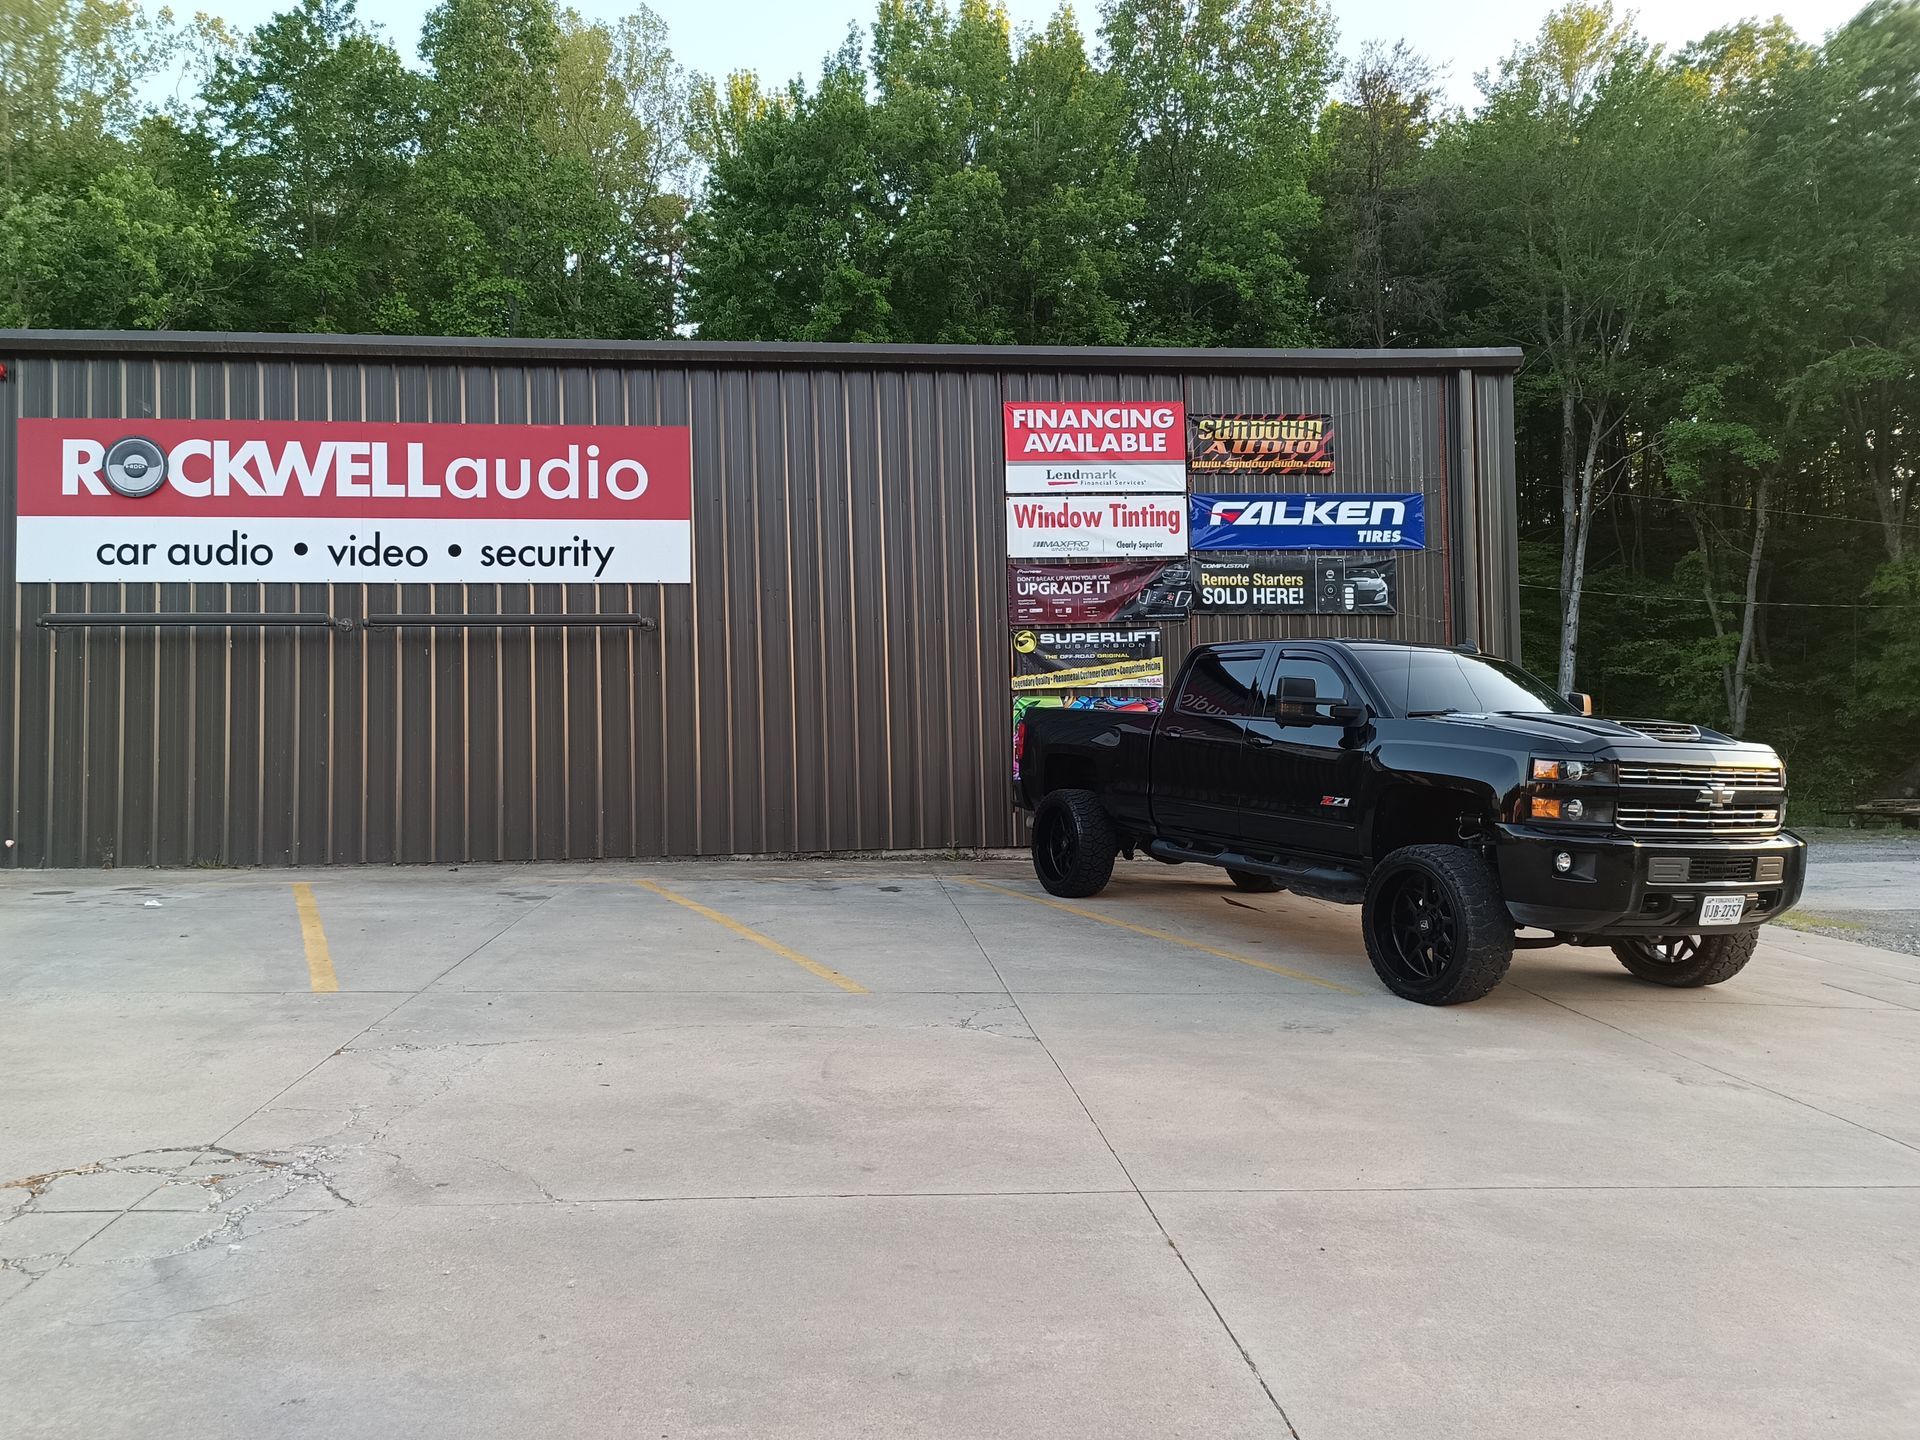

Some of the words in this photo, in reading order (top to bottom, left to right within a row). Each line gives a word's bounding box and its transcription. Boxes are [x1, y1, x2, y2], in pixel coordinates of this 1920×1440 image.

[1013, 408, 1175, 429] FINANCING
[1024, 432, 1167, 453] AVAILABLE
[1203, 440, 1319, 454] AUDIO
[1192, 459, 1331, 469] www.sundownaudio.com
[1046, 469, 1117, 480] Lendmark
[1013, 502, 1103, 528] Window
[1109, 503, 1180, 535] Tinting
[1207, 501, 1406, 526] FALKEN
[1357, 530, 1401, 543] TIRES
[1044, 540, 1090, 548] MAXPRO
[1116, 540, 1137, 550] Clearly
[1138, 540, 1163, 551] Superior
[97, 539, 156, 566] car
[168, 530, 274, 567] audio
[328, 532, 429, 568] video
[480, 535, 615, 577] security
[1201, 573, 1250, 586] Remote
[1253, 573, 1304, 586] Starters
[1017, 582, 1093, 596] UPGRADE
[1096, 580, 1111, 594] IT
[1202, 587, 1248, 605] SOLD
[1252, 587, 1304, 605] HERE!
[1040, 632, 1159, 644] SUPERLIFT
[1320, 796, 1351, 807] Z71
[1703, 904, 1742, 918] UJB-2757
